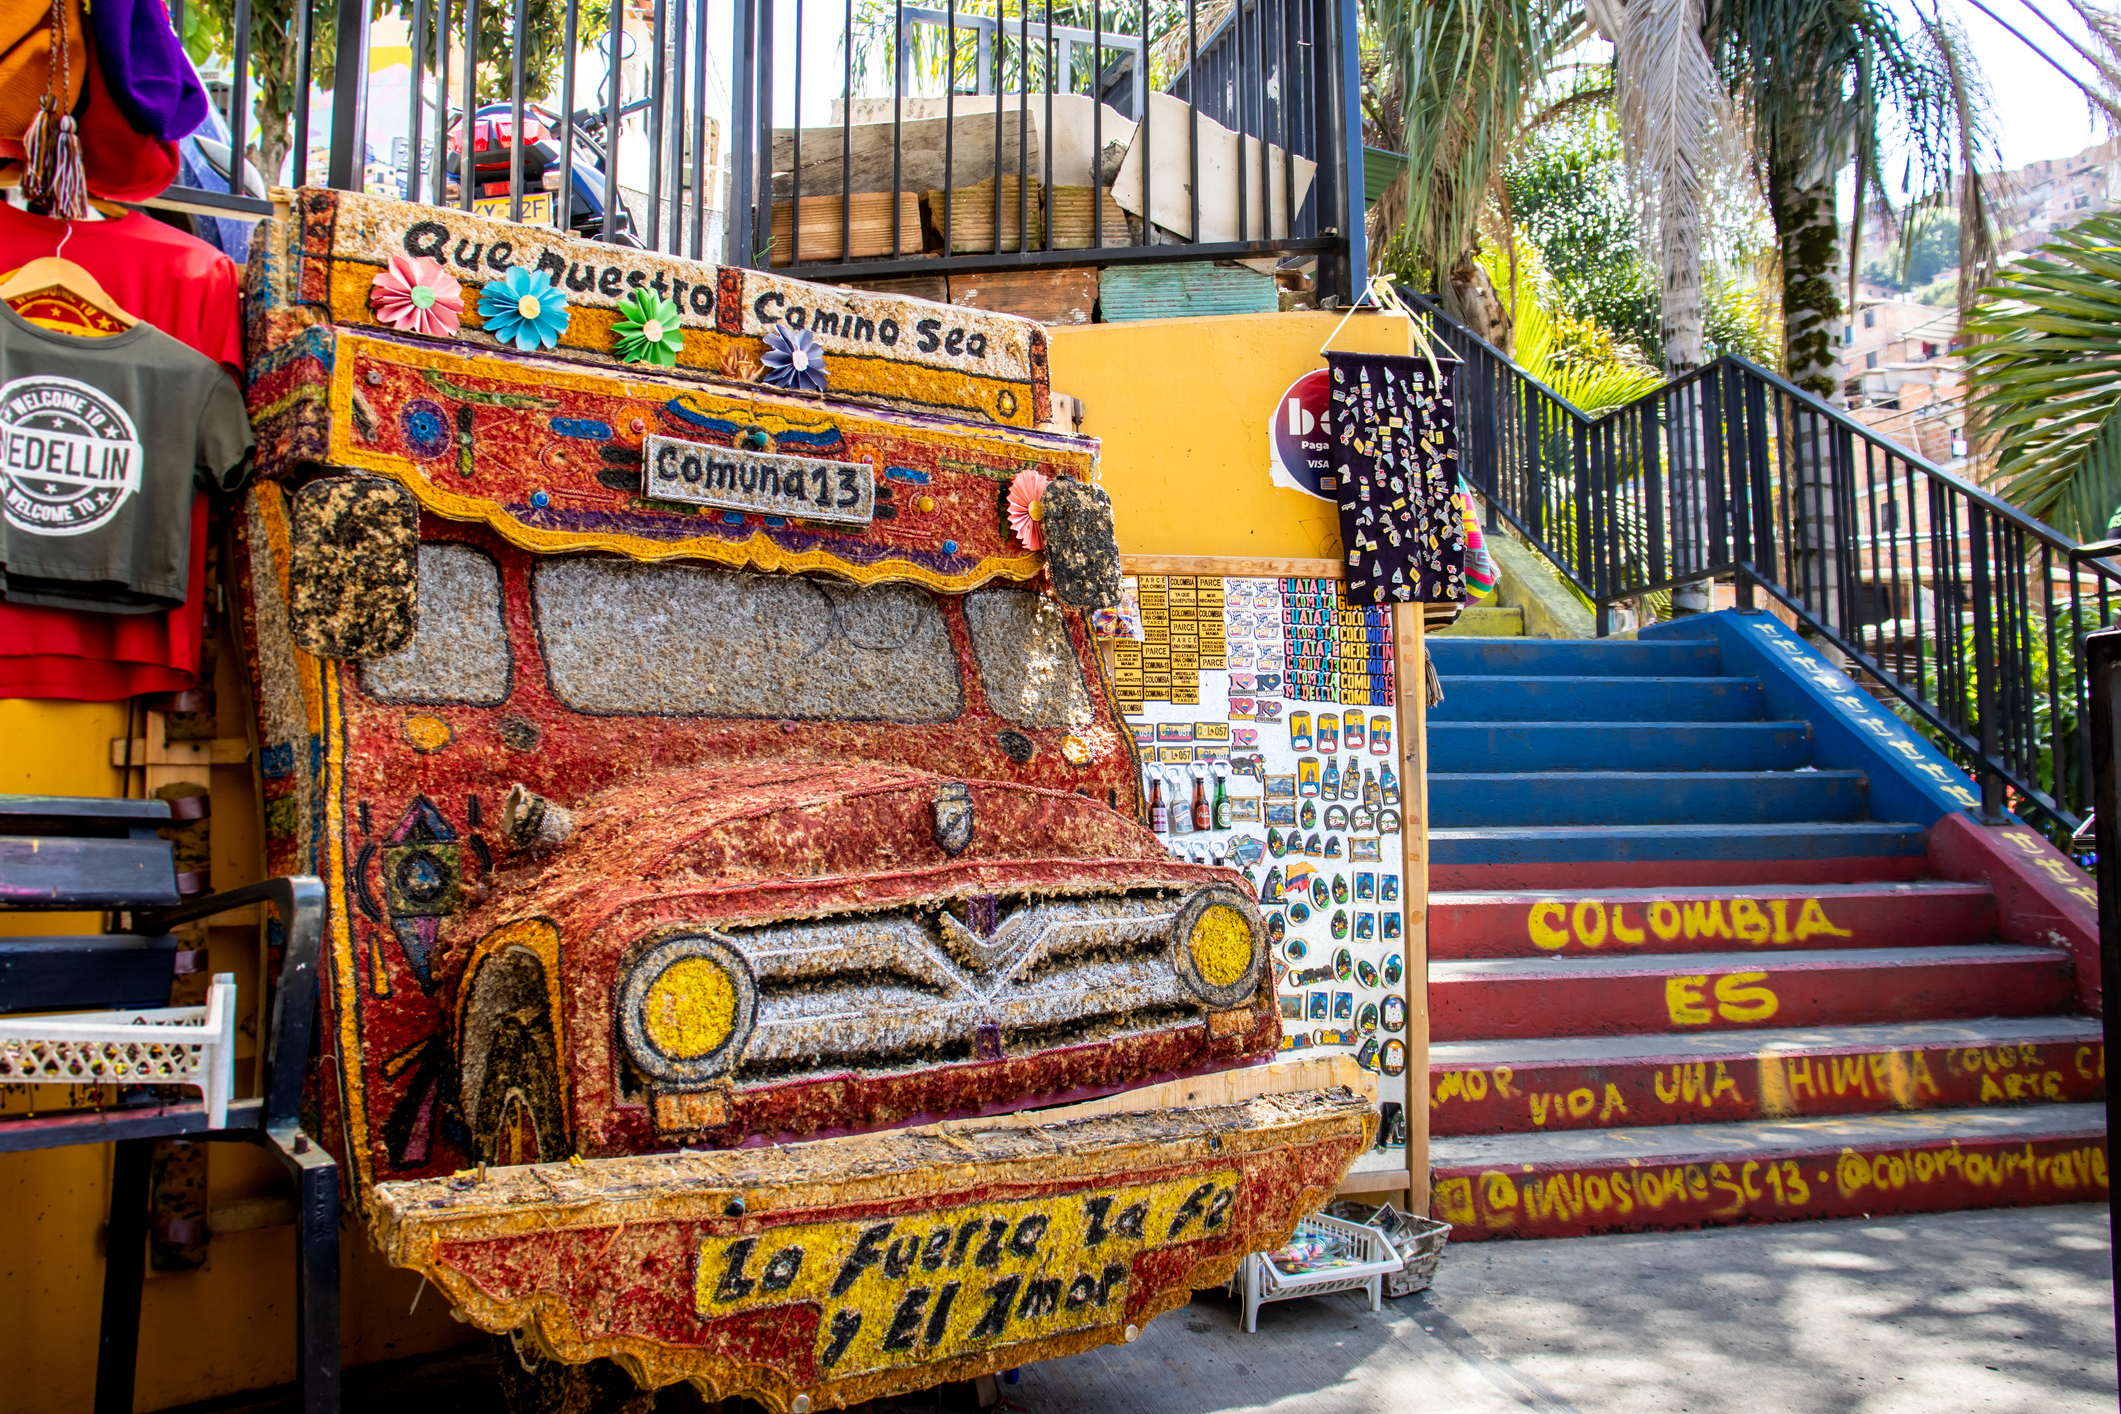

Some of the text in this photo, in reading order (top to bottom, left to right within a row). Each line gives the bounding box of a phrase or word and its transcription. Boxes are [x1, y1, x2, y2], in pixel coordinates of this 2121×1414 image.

[404, 221, 515, 272] Que
[754, 291, 987, 358] Camino Sea
[9, 391, 107, 427] WELCOME TO
[1301, 441, 1330, 452] Paga
[1306, 460, 1330, 469] VISA
[7, 488, 97, 521] WELCOME TO
[1279, 578, 1333, 594] GUATAPE
[1283, 595, 1336, 609] COLOMBIA
[1199, 610, 1222, 618] COLOMBIA
[1283, 609, 1337, 625] GUATAPE
[1339, 612, 1391, 627] COLOMBIA
[1284, 626, 1337, 640] COLOMBIA
[1340, 627, 1393, 643] COLOMBIA
[1285, 640, 1340, 657] GUATAPE
[1340, 643, 1394, 659] MEDELLIN
[1340, 659, 1393, 675] COLOMBIA
[1284, 670, 1338, 688] COLOMBIA
[1284, 685, 1338, 702] MEDELLIN
[1528, 897, 1852, 950] COLOMBIA
[1665, 971, 1779, 1025] ES
[1430, 1066, 1521, 1108] MOR
[1529, 1082, 1628, 1126] VIDA
